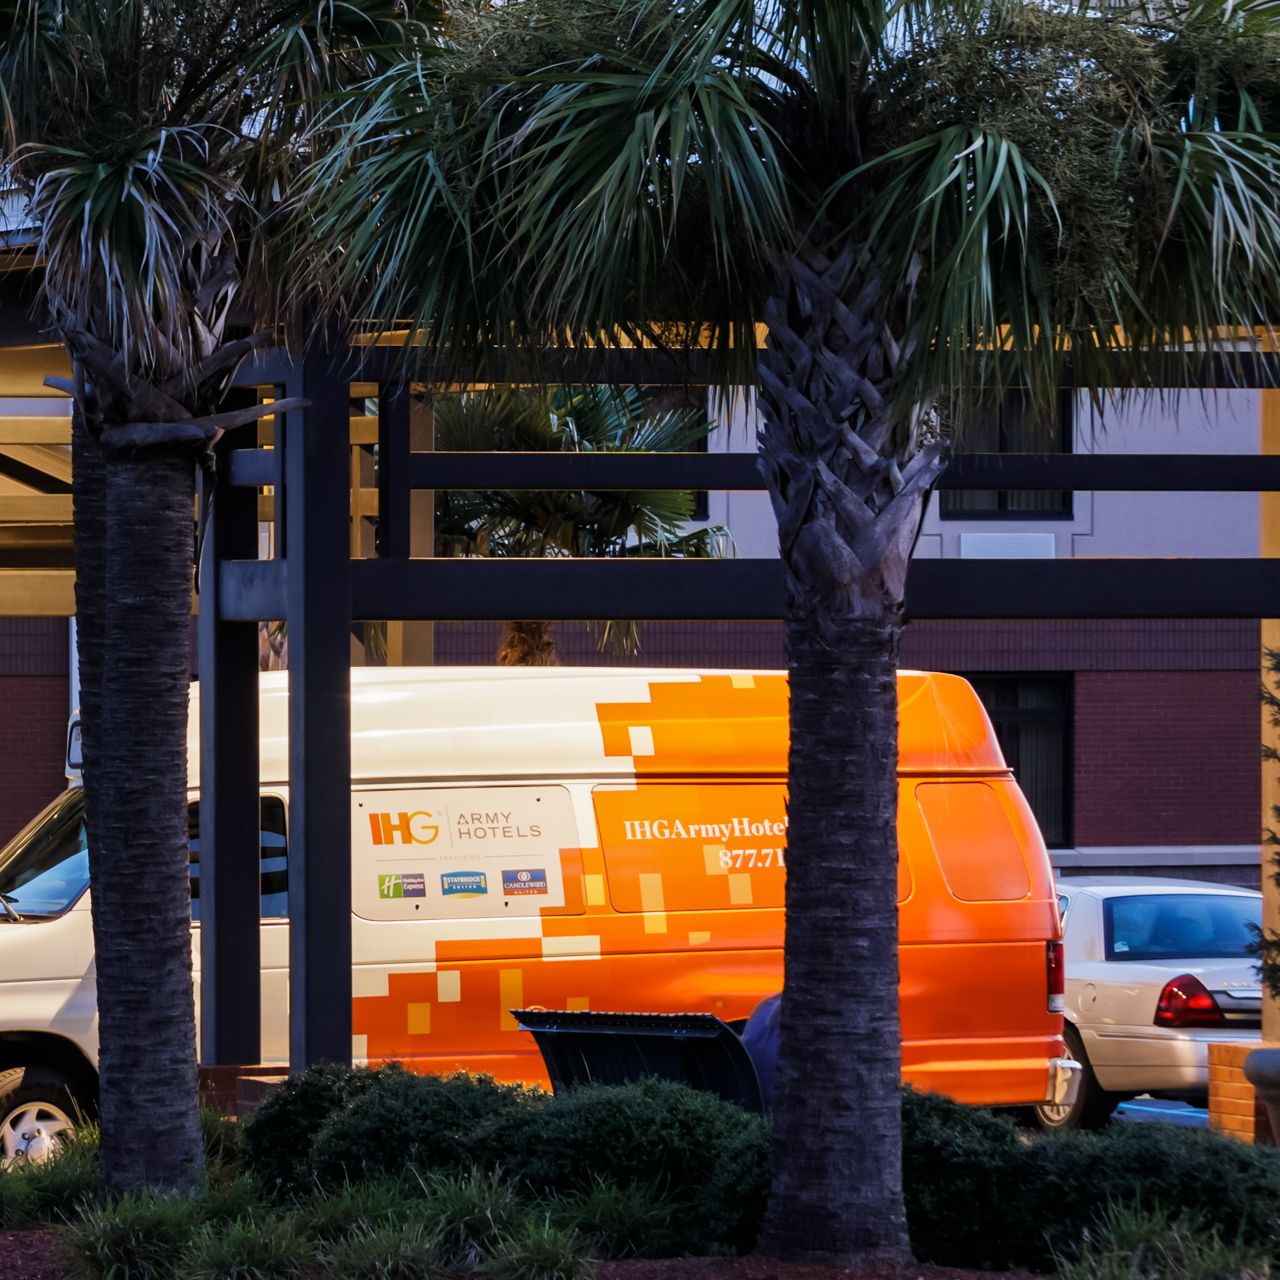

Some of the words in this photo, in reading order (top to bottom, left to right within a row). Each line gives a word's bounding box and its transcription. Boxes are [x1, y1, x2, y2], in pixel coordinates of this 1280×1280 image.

[457, 812, 512, 825] ARMY
[368, 811, 439, 845] IHG
[458, 825, 542, 840] HOTELS
